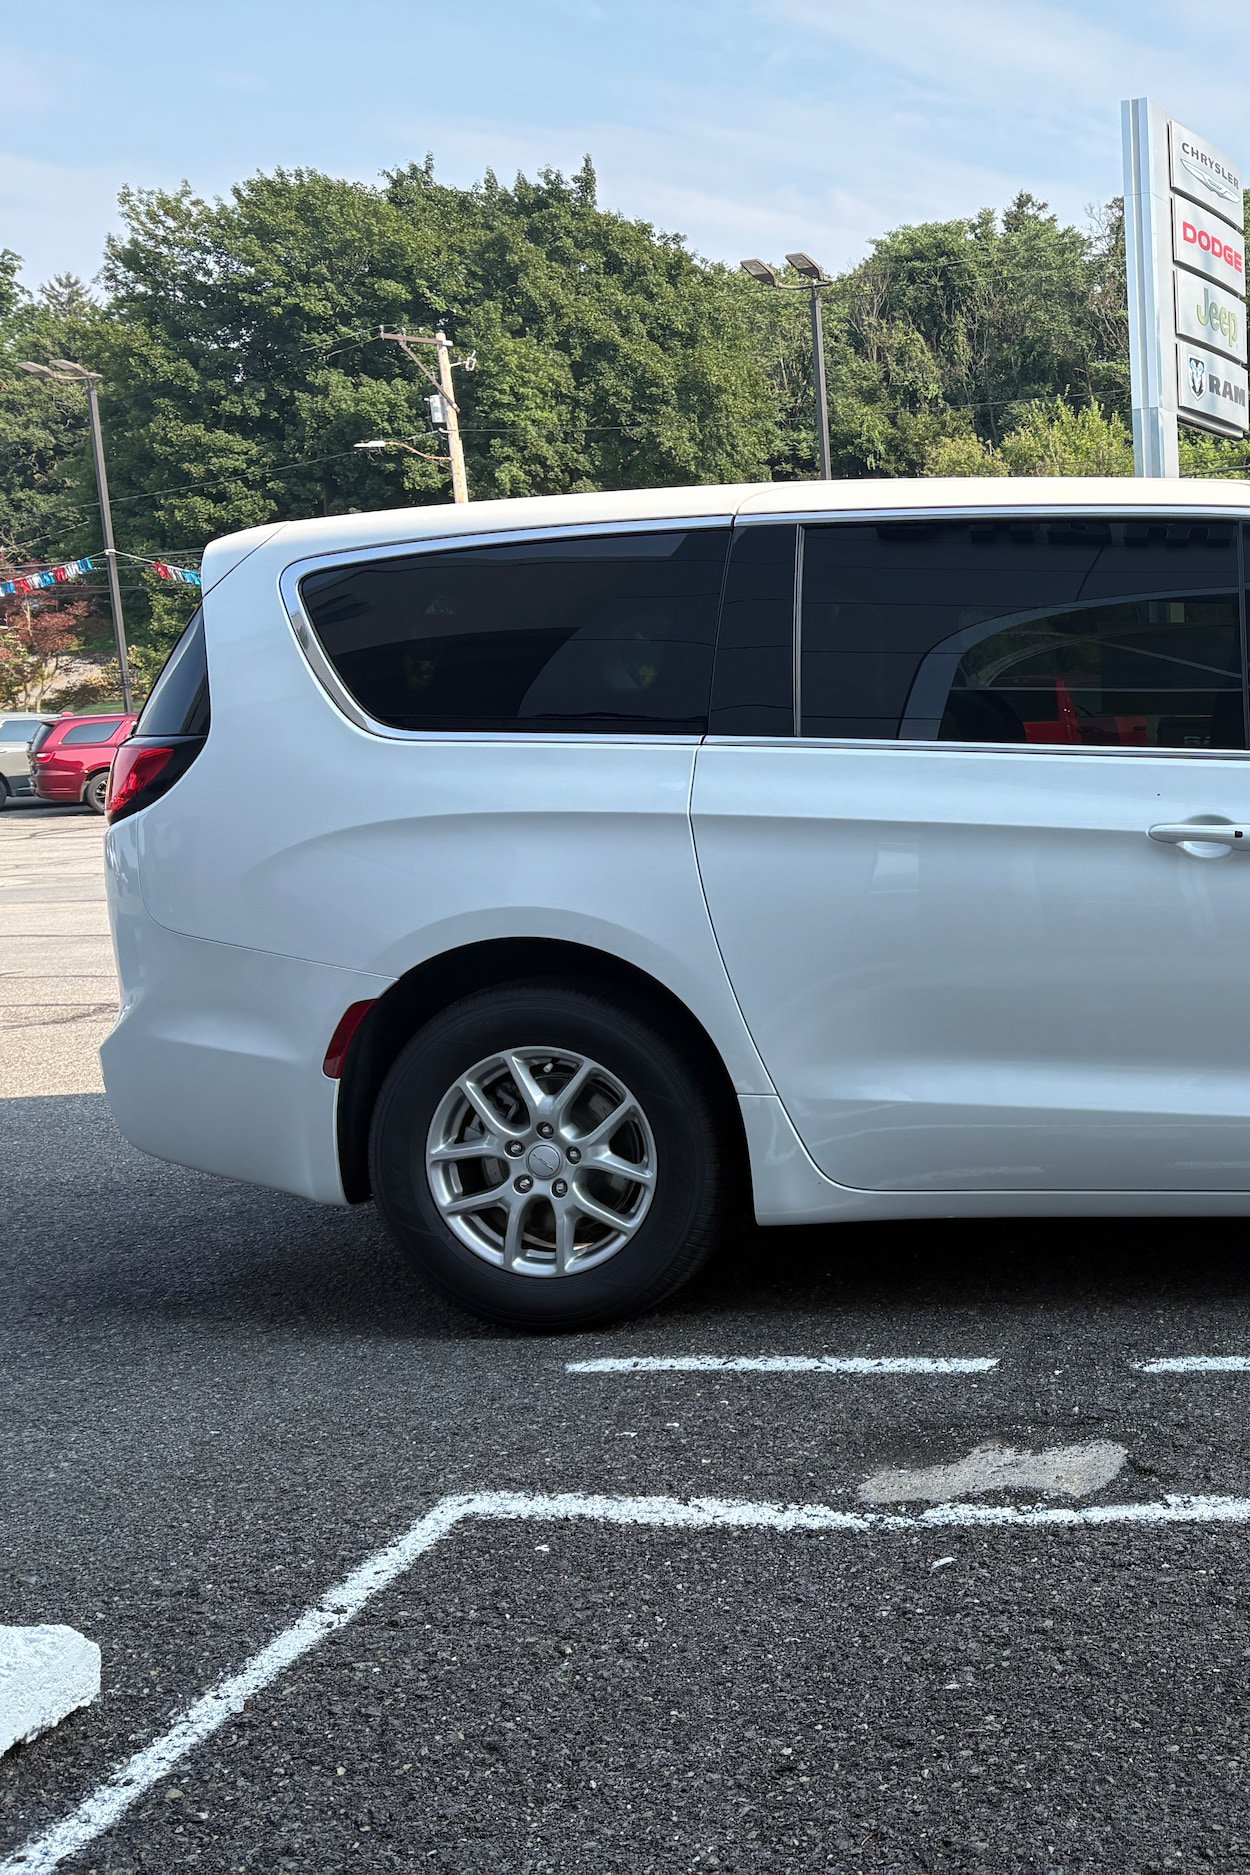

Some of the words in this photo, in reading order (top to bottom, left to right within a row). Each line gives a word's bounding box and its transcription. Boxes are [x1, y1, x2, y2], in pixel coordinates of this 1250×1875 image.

[1182, 142, 1239, 189] CHRYSLER
[1182, 220, 1243, 274] DODGE
[1196, 287, 1239, 347] Jeep
[1208, 376, 1247, 408] RAM
